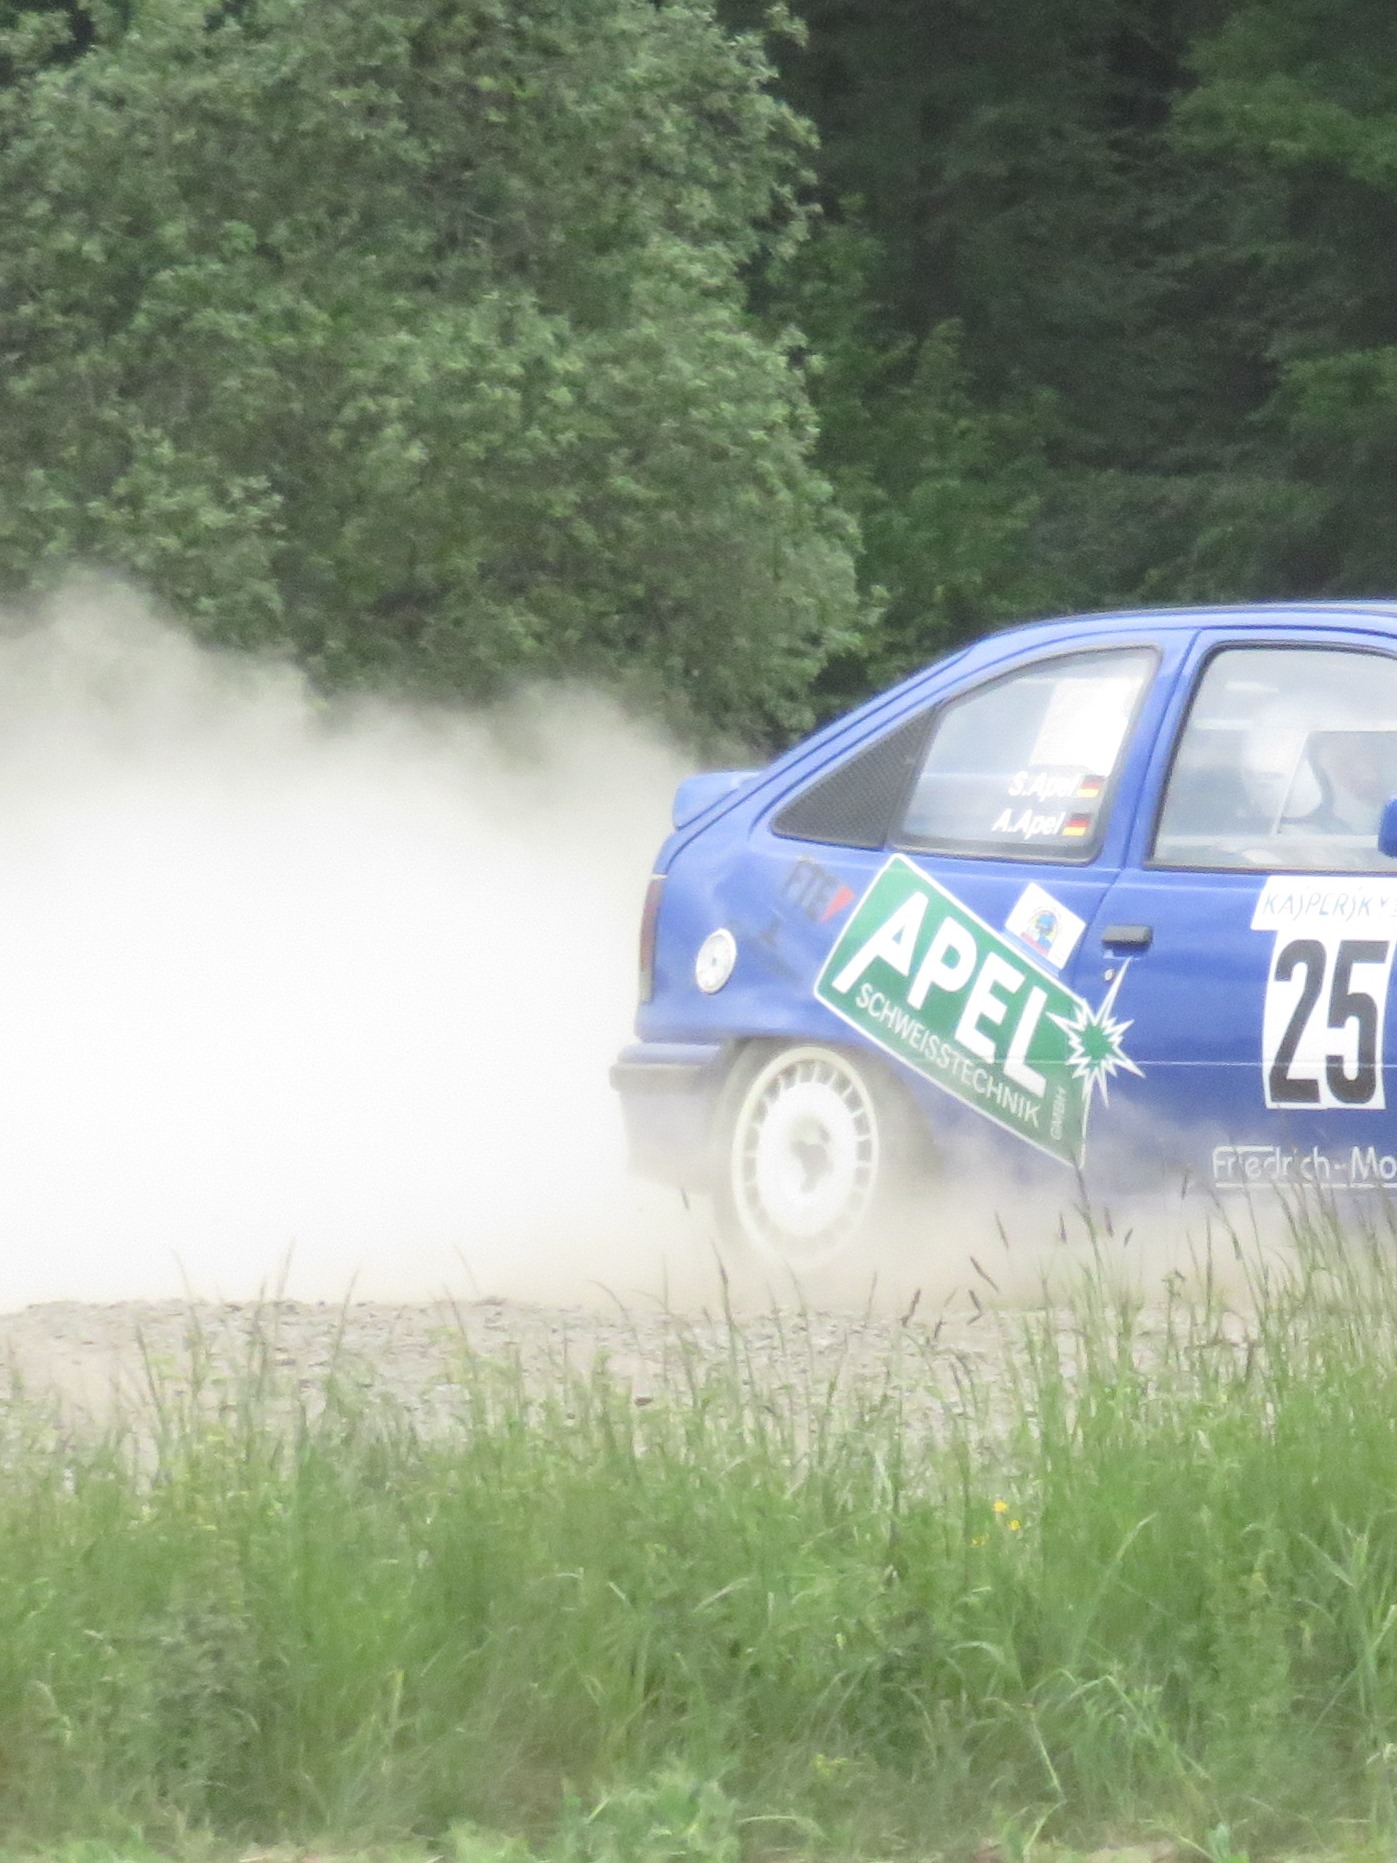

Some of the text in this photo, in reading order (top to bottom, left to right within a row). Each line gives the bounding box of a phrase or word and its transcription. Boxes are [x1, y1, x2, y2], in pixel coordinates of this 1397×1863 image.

[992, 808, 1066, 840] A.Apel
[831, 891, 1047, 1097] APEL
[855, 982, 1041, 1128] SCHWEISSTECHNIK
[1269, 938, 1390, 1104] 25
